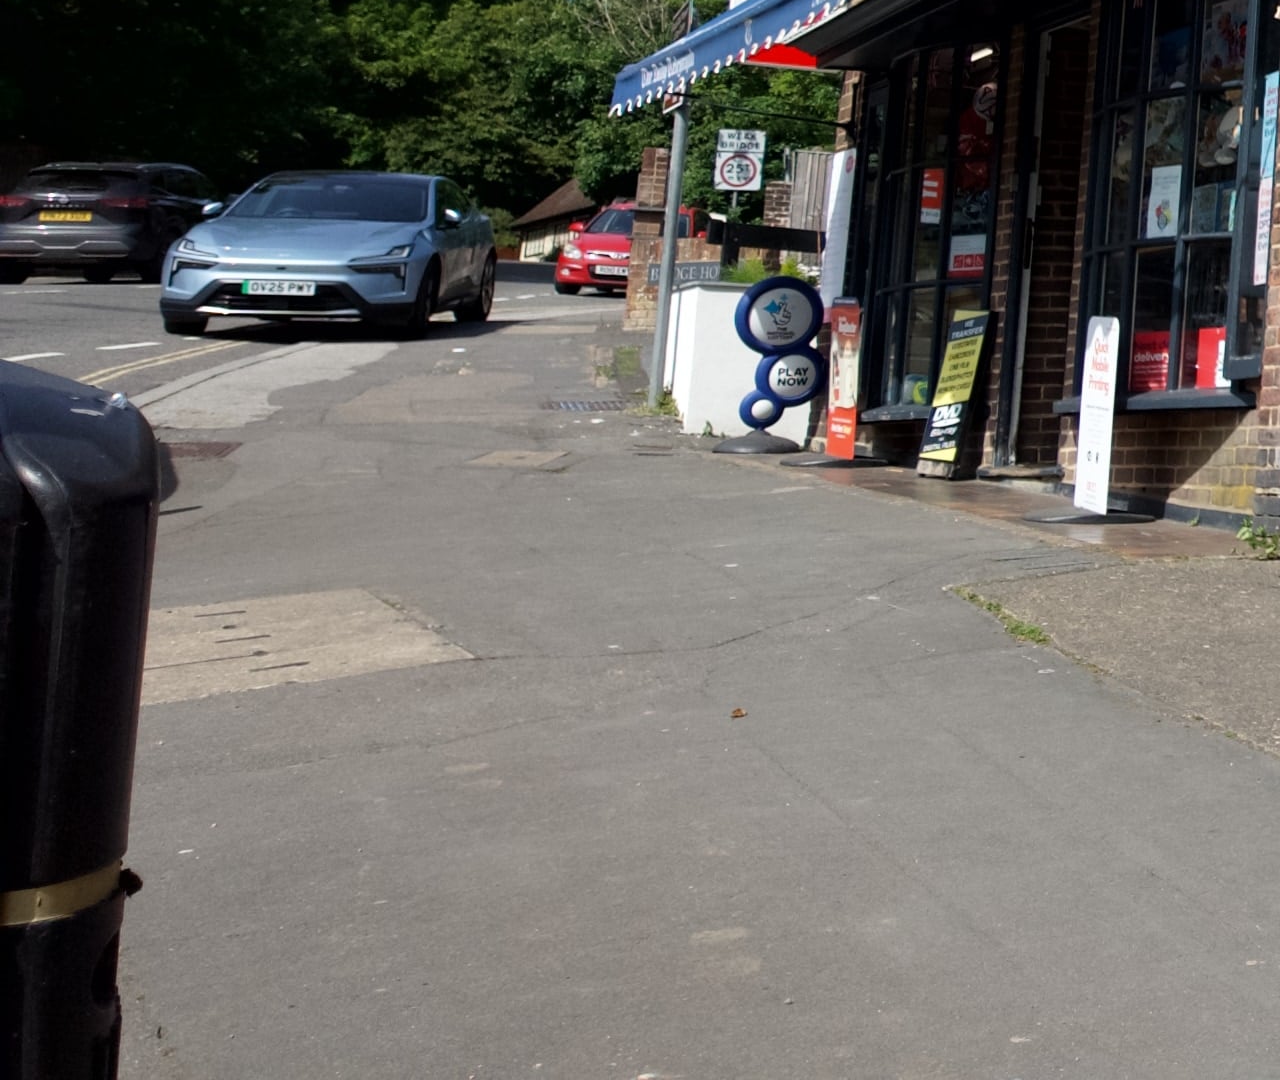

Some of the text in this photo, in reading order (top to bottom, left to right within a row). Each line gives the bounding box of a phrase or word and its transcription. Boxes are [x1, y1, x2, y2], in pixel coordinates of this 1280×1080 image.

[777, 368, 809, 377] PLAY
[777, 377, 808, 387] NOW
[932, 404, 962, 422] DVD
